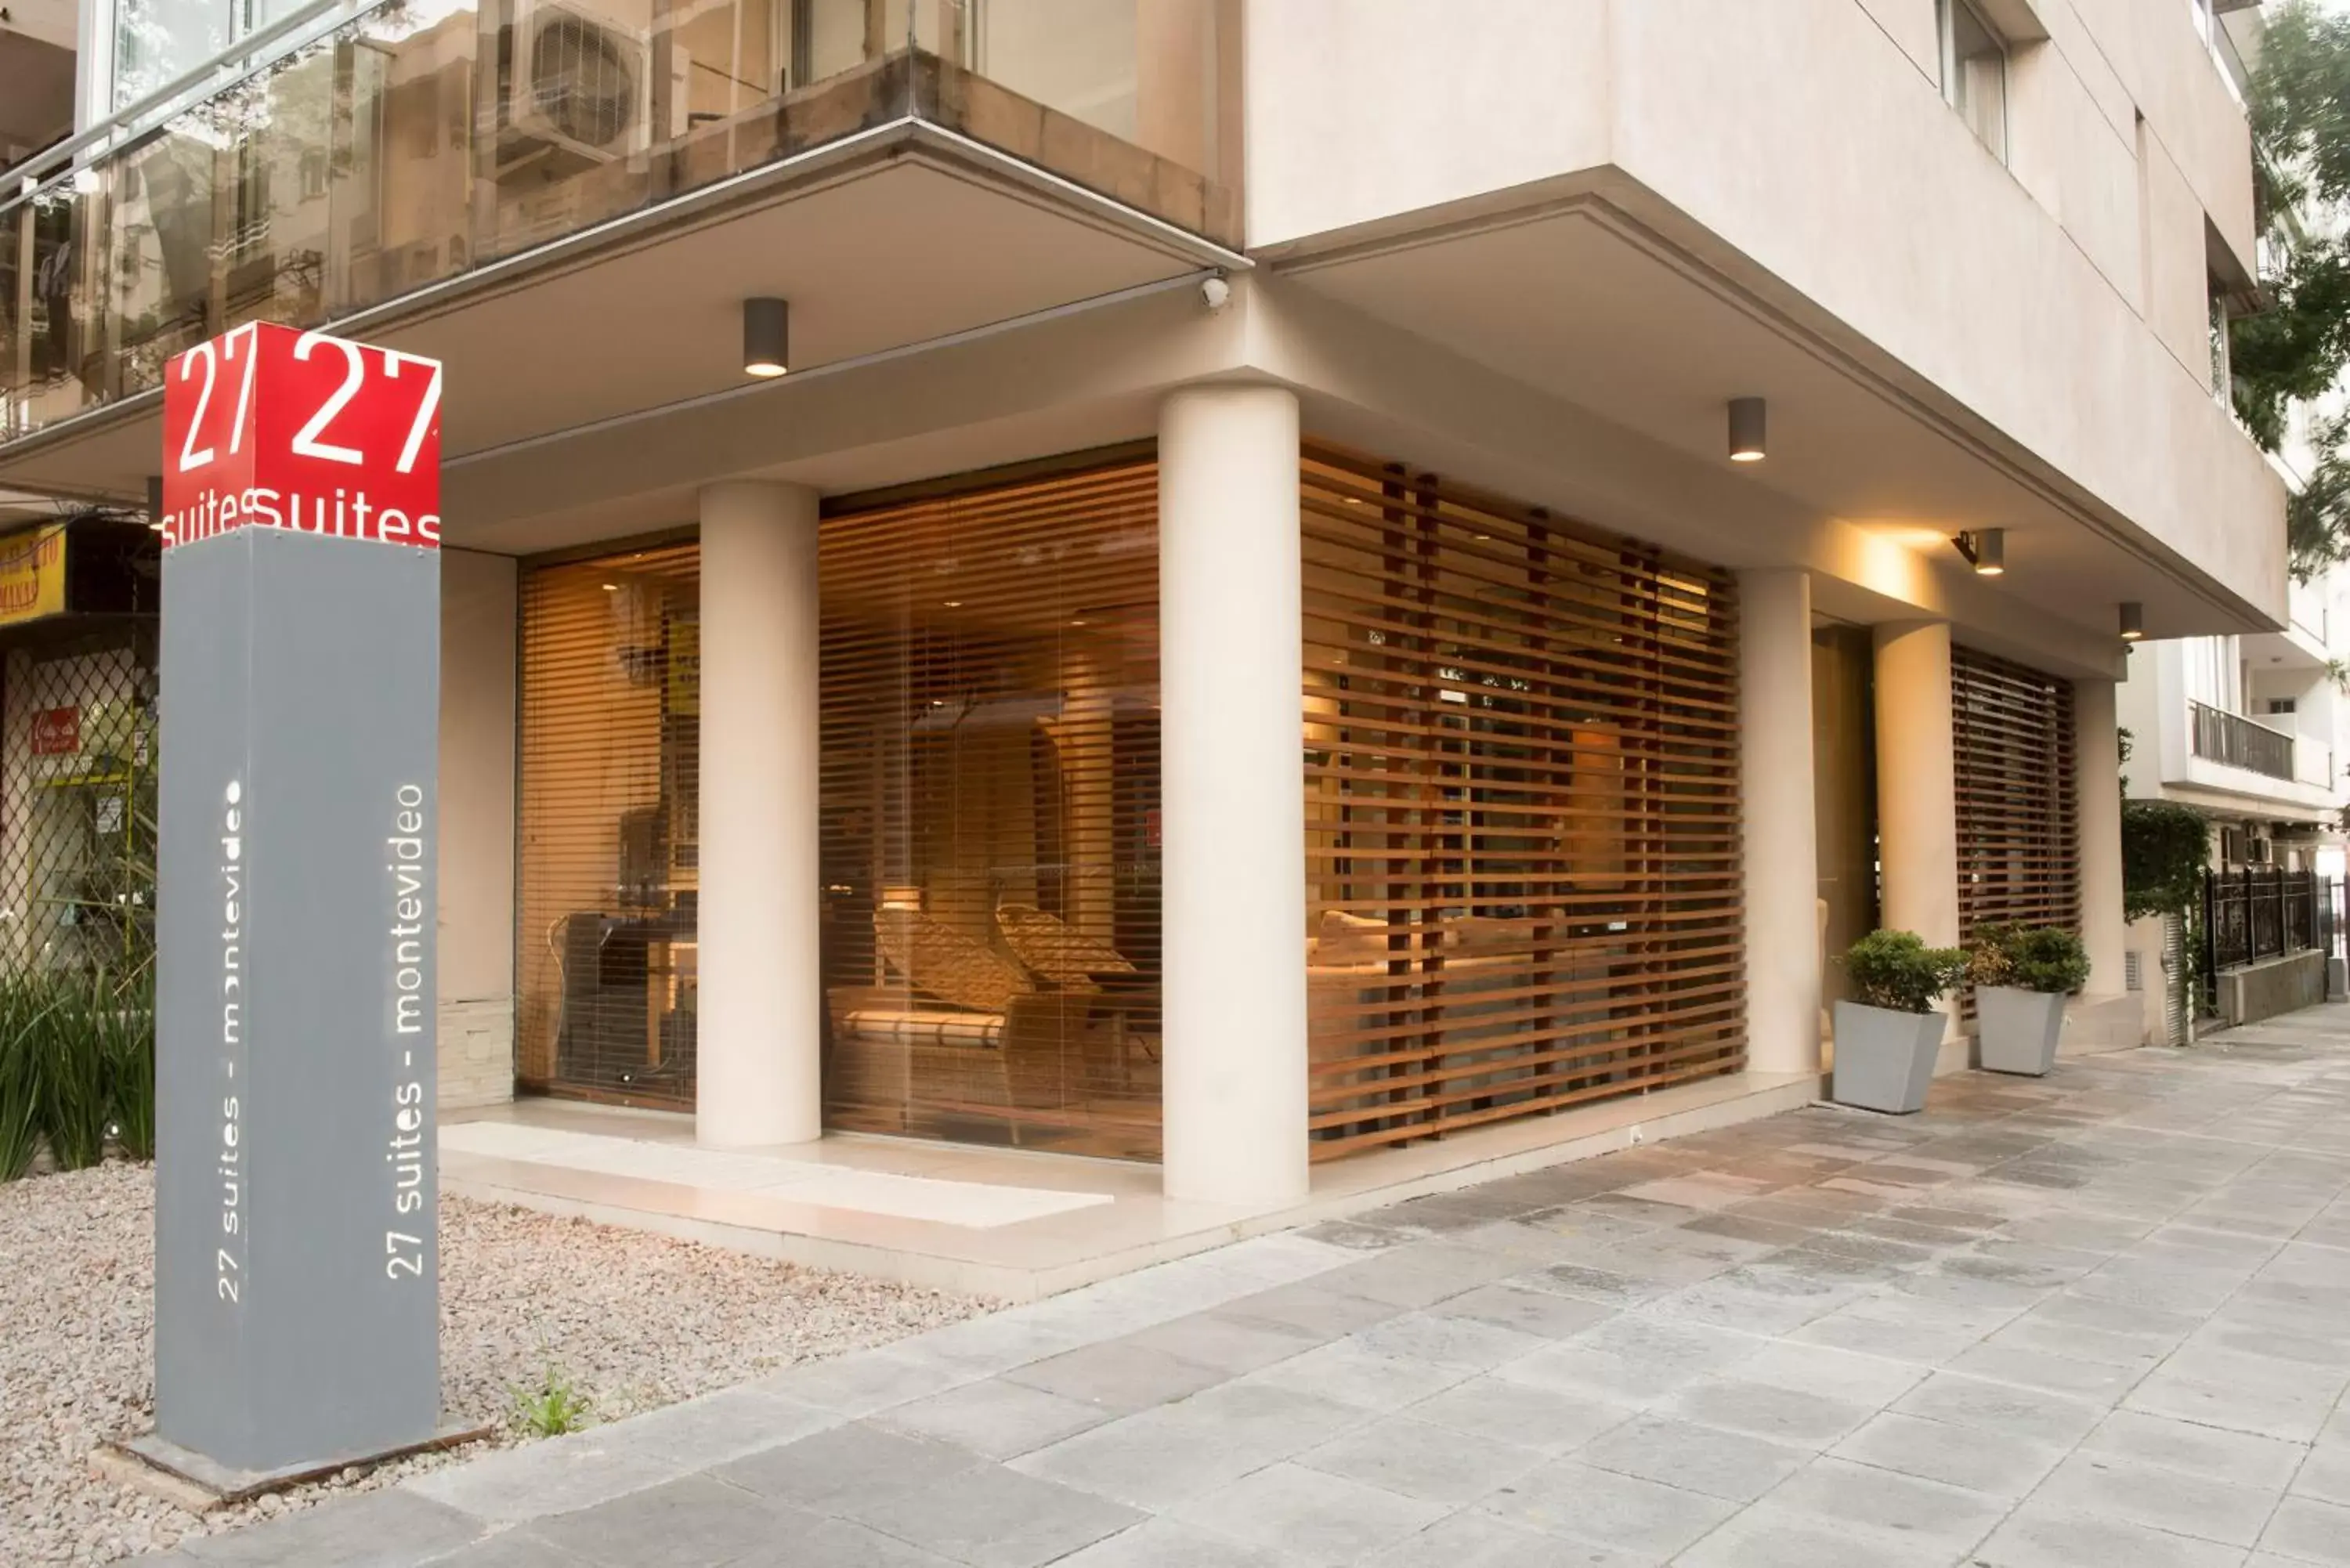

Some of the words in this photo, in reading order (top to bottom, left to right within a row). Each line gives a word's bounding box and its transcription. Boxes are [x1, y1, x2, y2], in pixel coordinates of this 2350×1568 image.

[179, 320, 257, 472] 27
[292, 331, 443, 474] 27
[252, 488, 441, 551] suites
[387, 783, 424, 1035] montevideo
[405, 1050, 411, 1067] -
[218, 1096, 239, 1235] suites
[386, 1081, 423, 1214] suites
[218, 1248, 239, 1304] 27
[386, 1230, 423, 1280] 27
